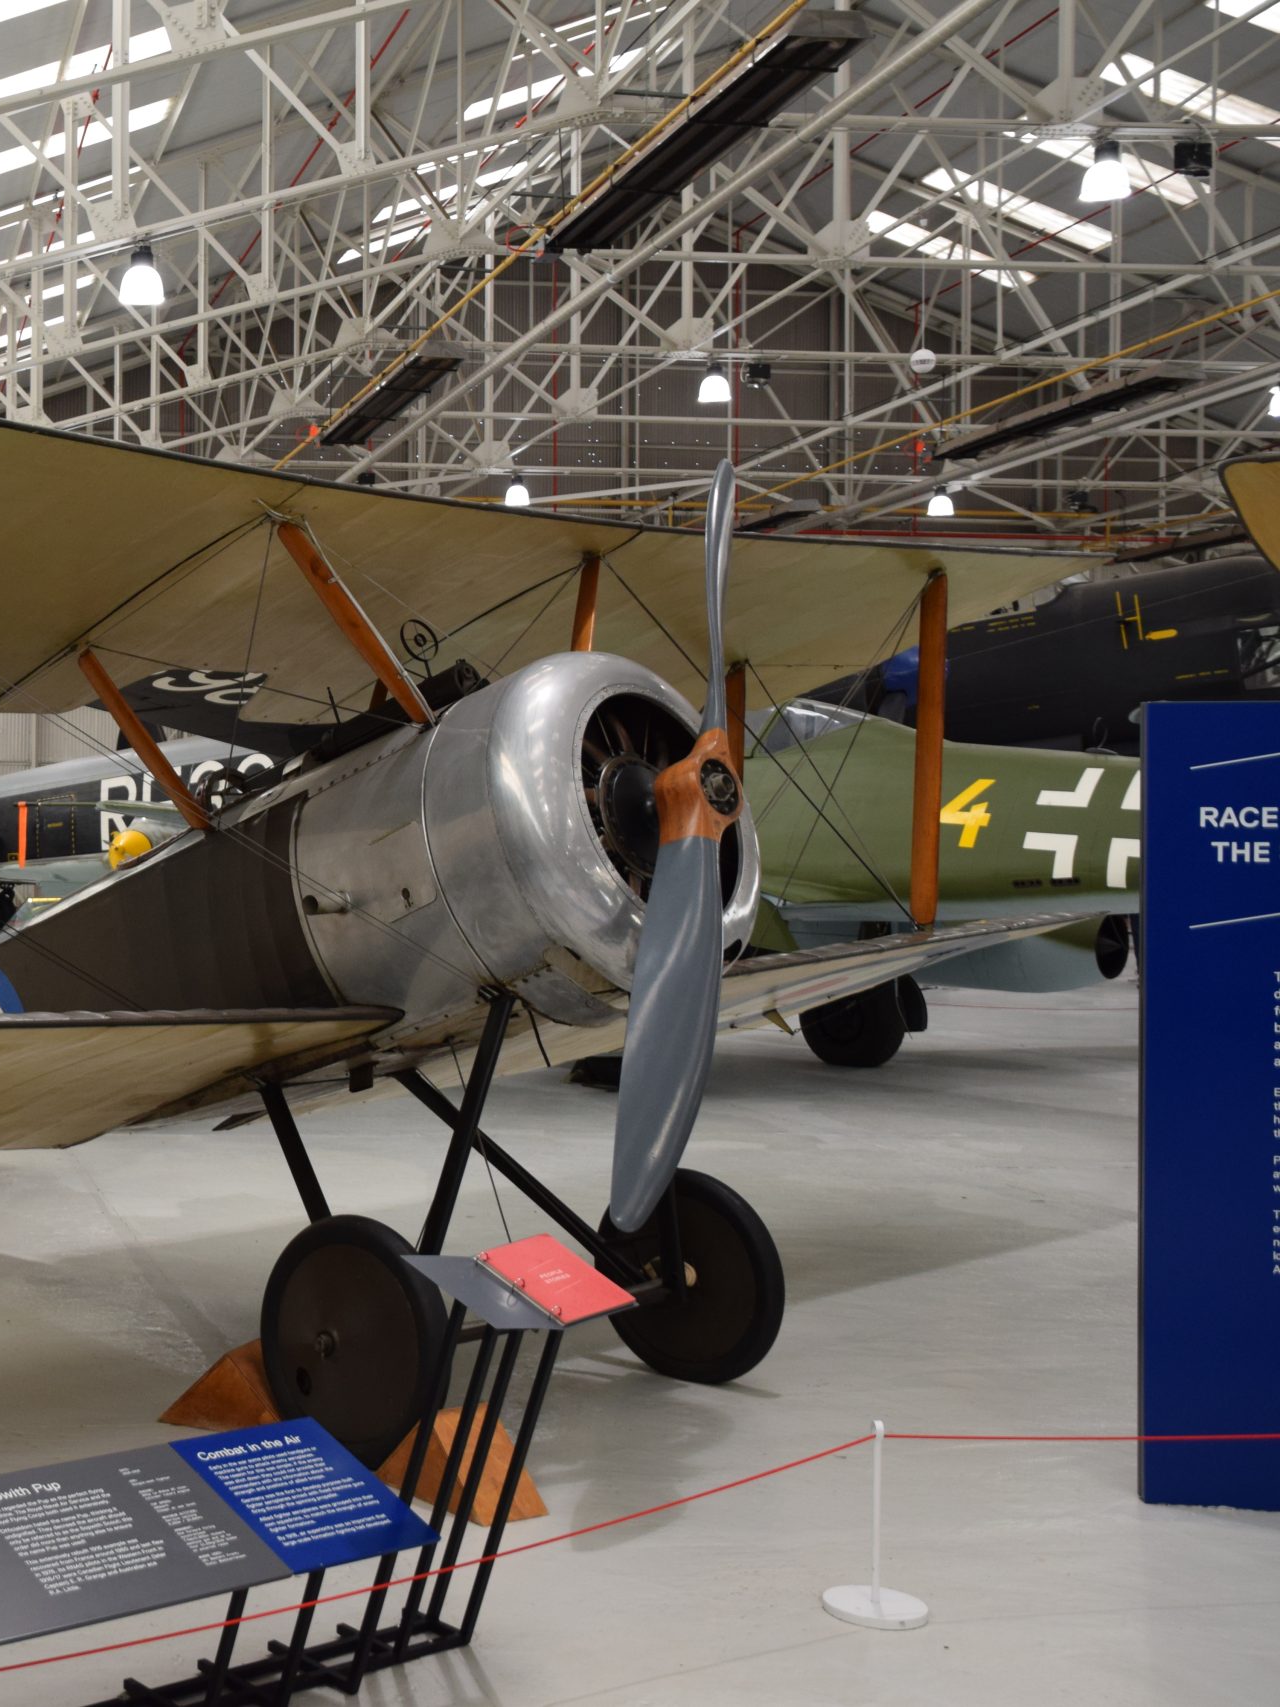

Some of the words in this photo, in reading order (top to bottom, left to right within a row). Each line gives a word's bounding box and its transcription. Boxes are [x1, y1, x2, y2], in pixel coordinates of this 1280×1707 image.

[940, 779, 996, 848] 4
[1199, 806, 1279, 828] RACE
[1211, 841, 1271, 863] THE
[197, 1446, 247, 1460] Combat
[246, 1444, 261, 1452] in
[261, 1440, 283, 1448] the
[284, 1436, 300, 1444] Air
[32, 1482, 60, 1493] Pup
